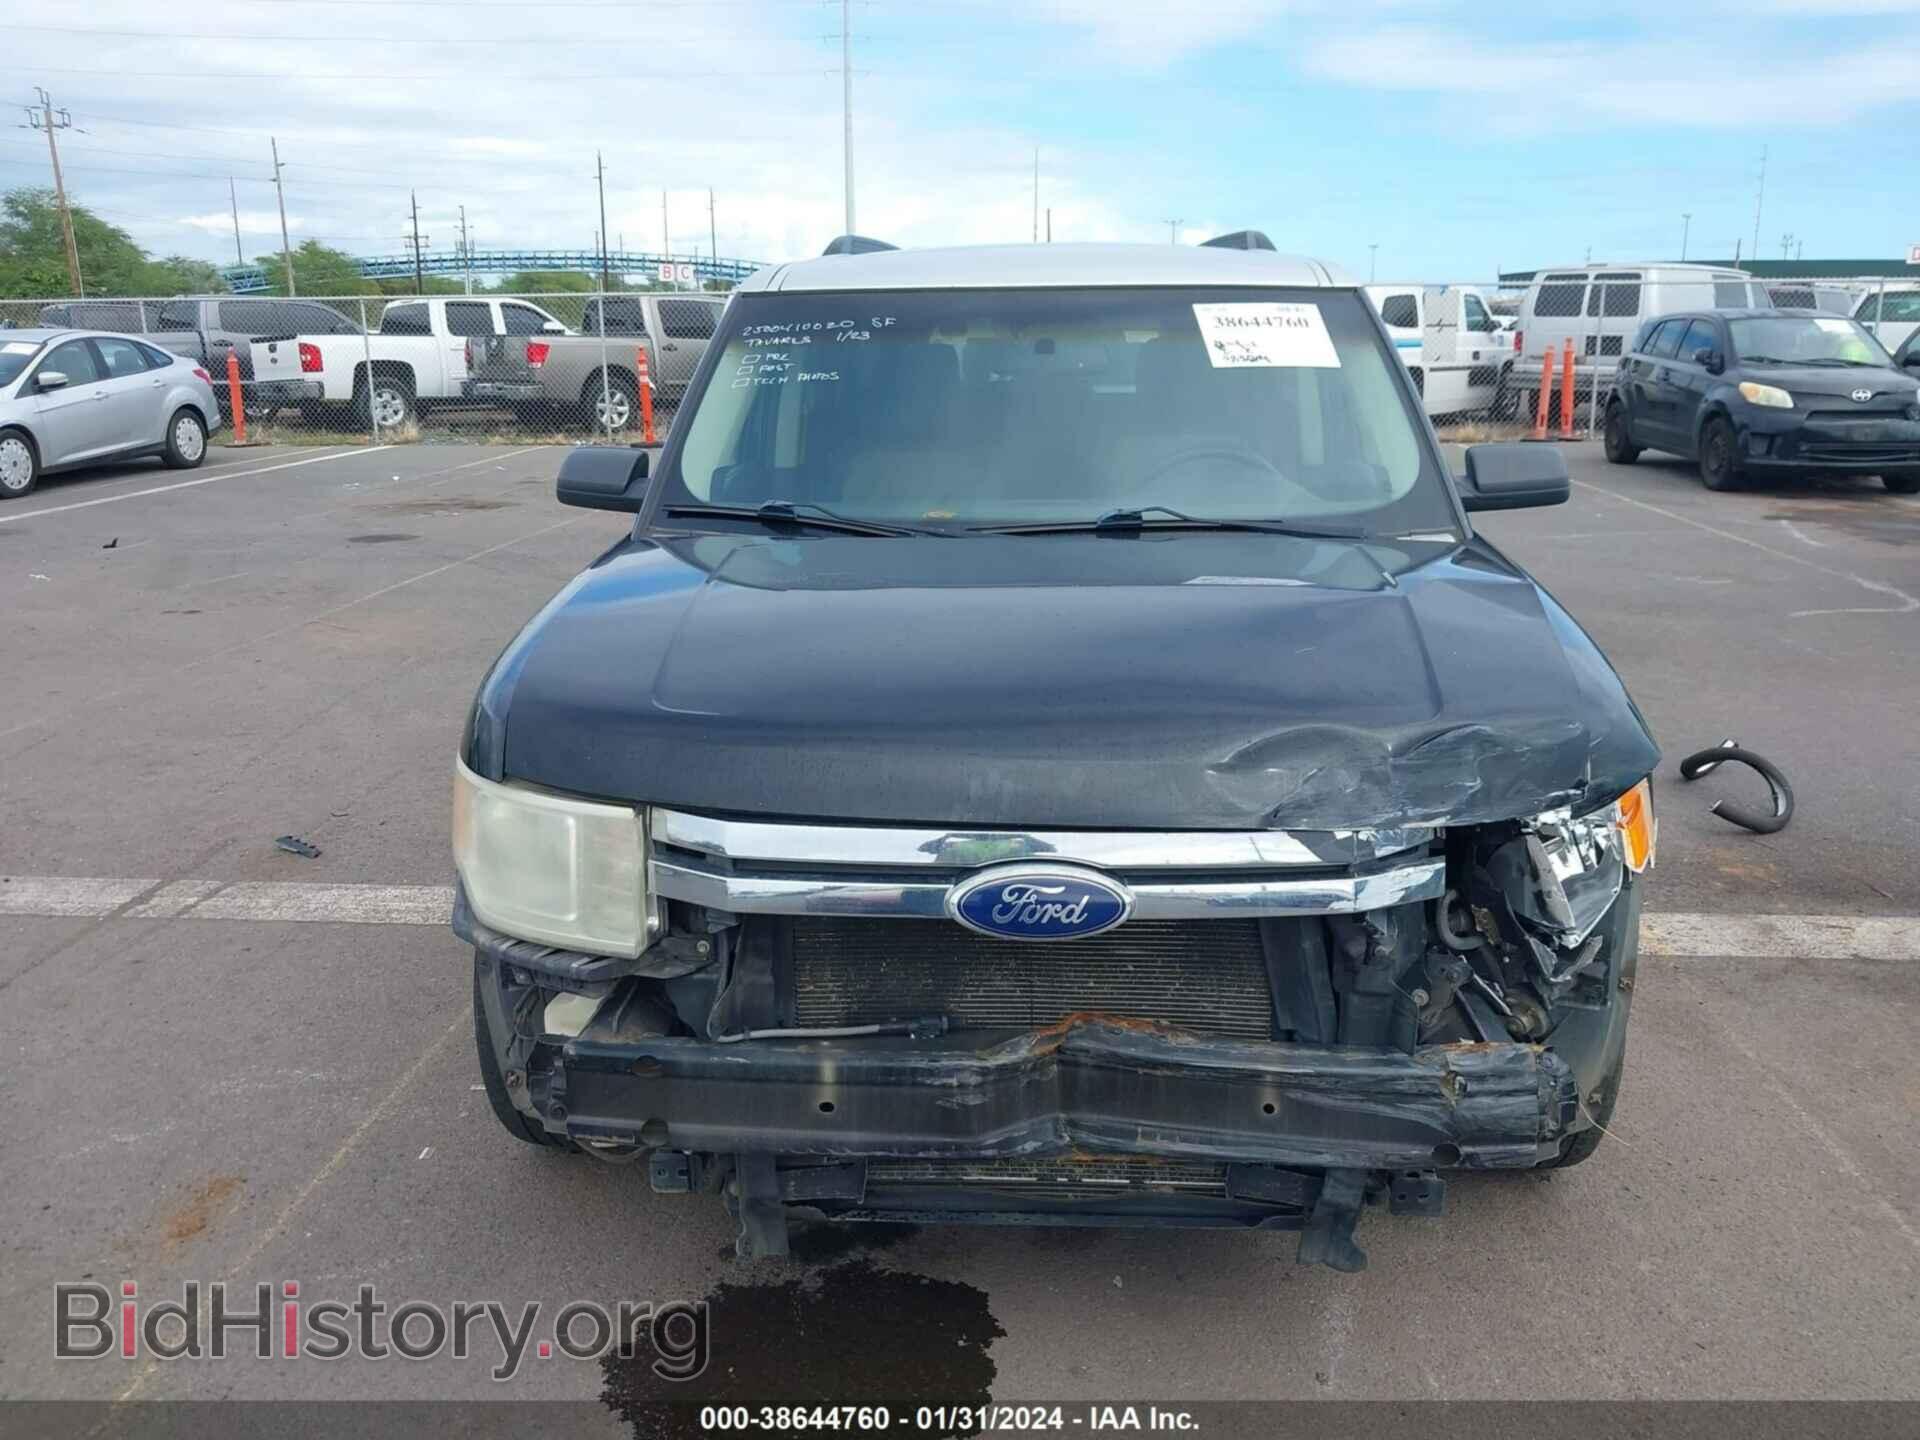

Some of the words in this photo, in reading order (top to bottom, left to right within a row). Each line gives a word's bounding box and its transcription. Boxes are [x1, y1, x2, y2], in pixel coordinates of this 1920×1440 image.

[663, 265, 672, 279] B
[680, 265, 689, 280] C
[871, 316, 897, 328] SF
[1213, 315, 1310, 329] 38644760
[991, 883, 1090, 924] Ford
